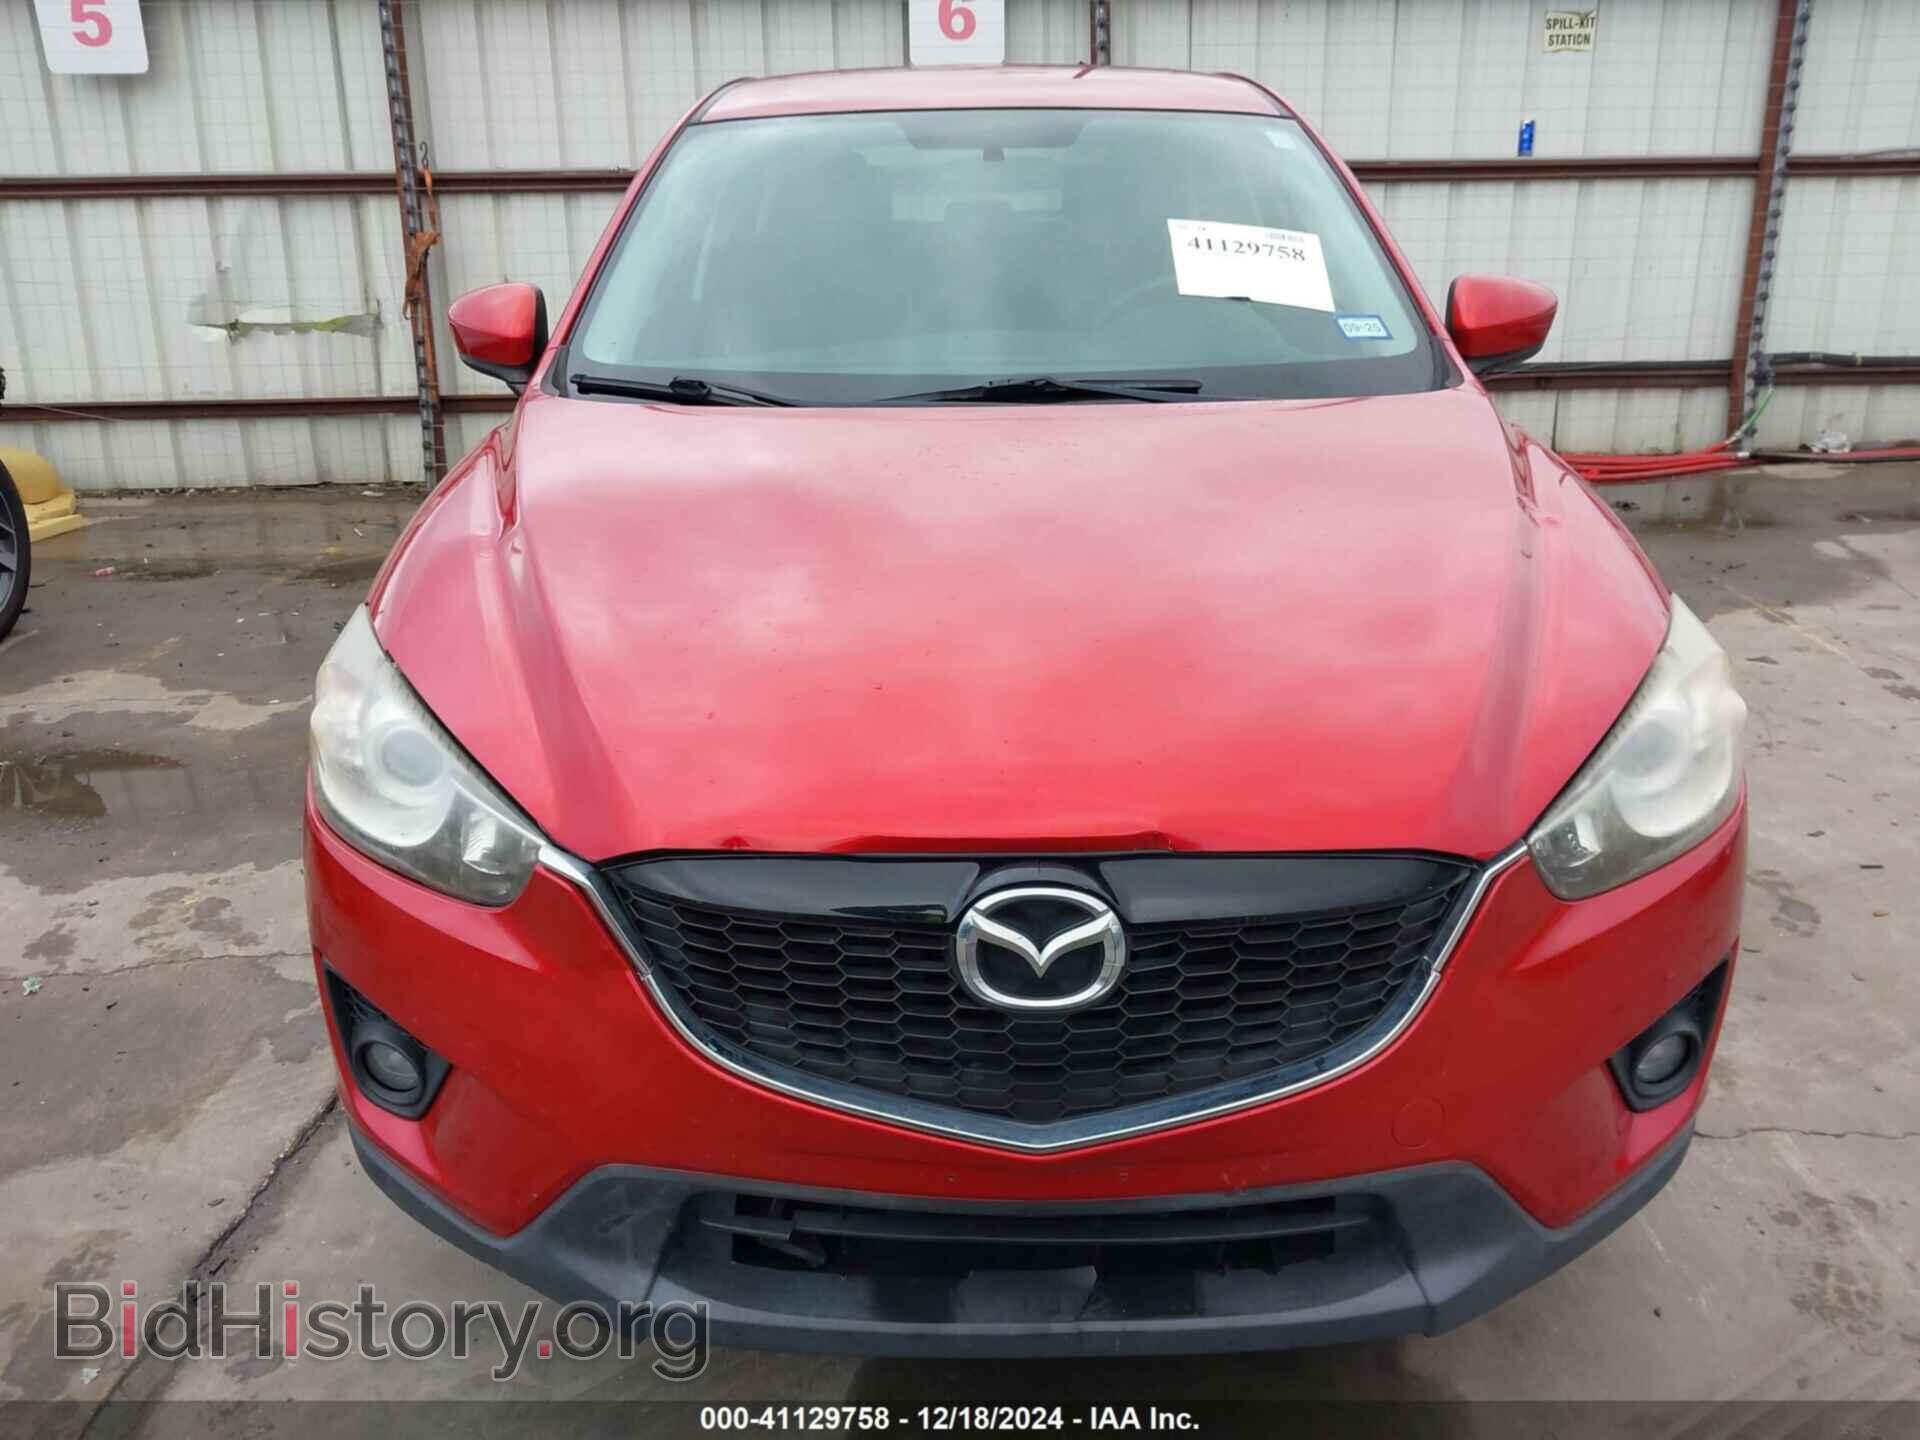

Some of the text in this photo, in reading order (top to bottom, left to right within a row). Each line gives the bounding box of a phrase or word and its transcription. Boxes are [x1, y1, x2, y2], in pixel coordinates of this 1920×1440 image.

[71, 0, 113, 47] 5
[938, 0, 977, 41] 6
[1545, 17, 1596, 30] SPILL-KIT
[1548, 33, 1591, 47] STATION
[1186, 235, 1306, 262] 41129758
